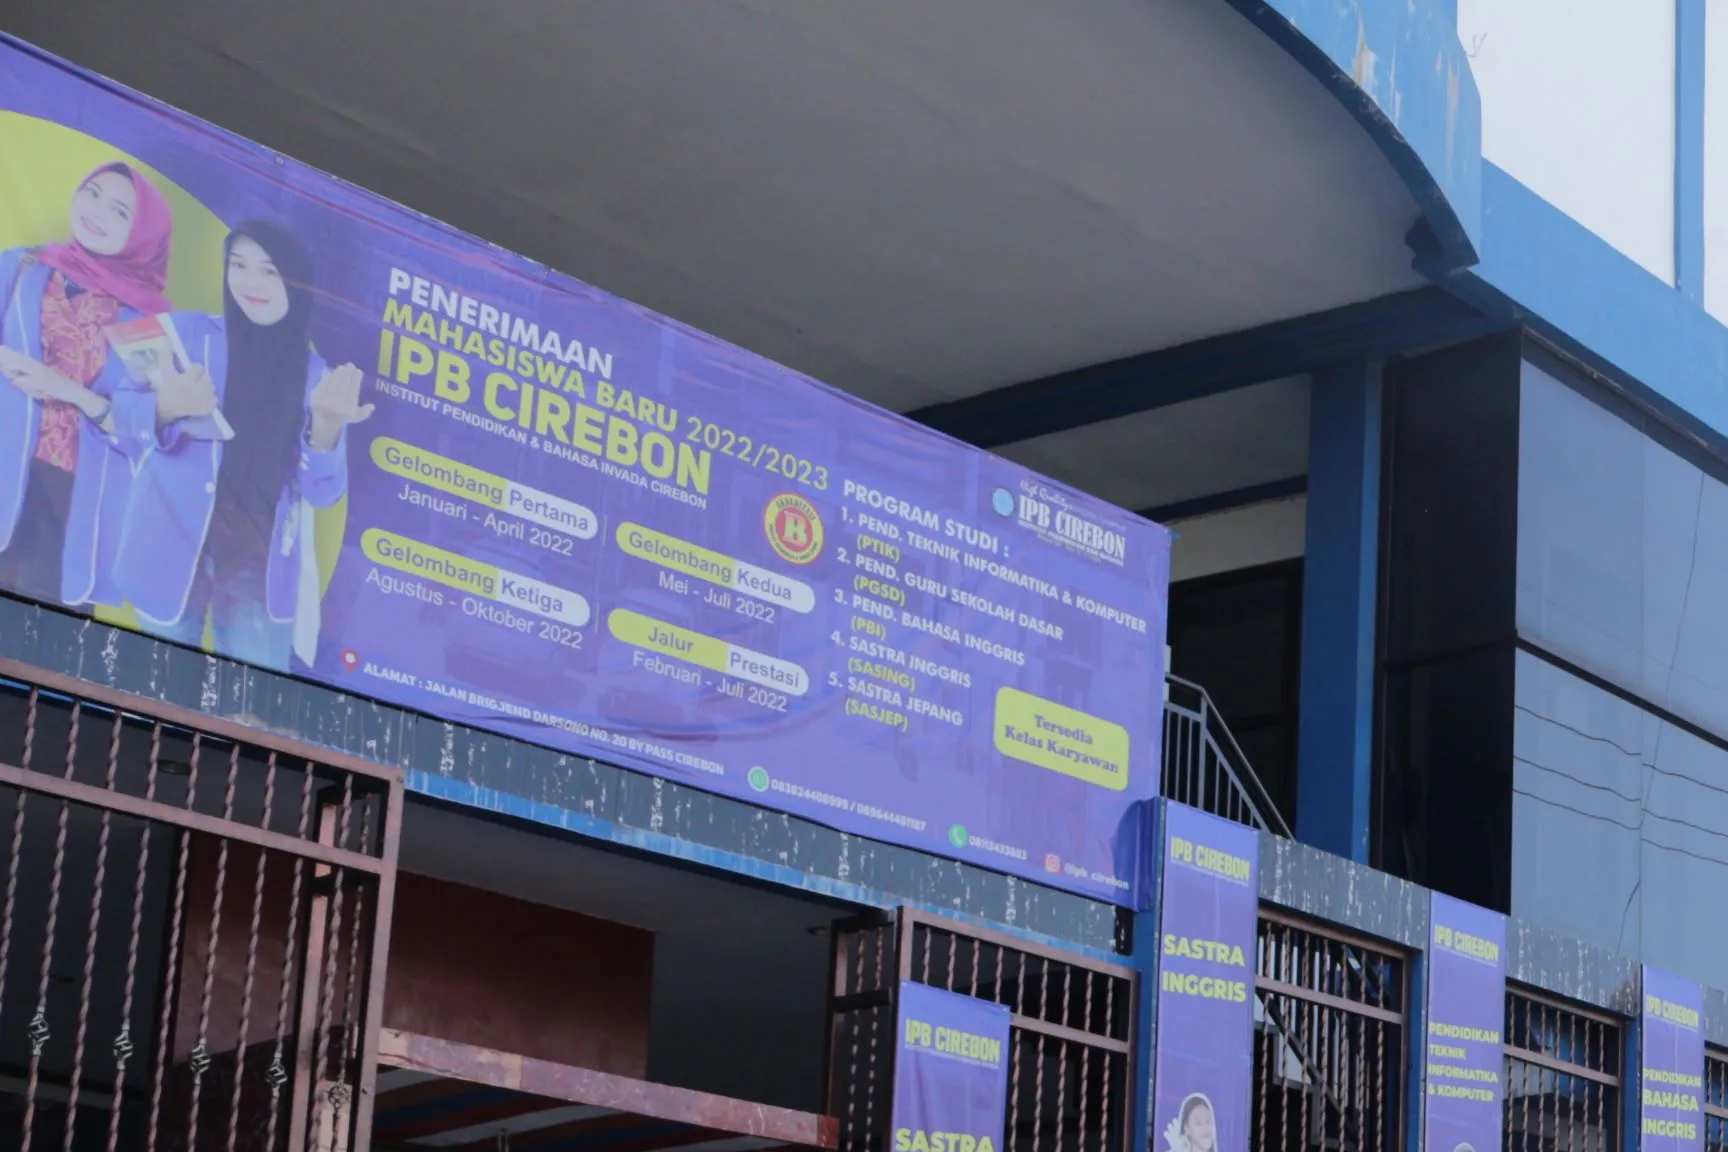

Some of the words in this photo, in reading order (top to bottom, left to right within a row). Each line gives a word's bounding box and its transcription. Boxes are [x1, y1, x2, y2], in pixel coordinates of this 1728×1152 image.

[390, 267, 612, 378] PENERIMAAN
[377, 329, 471, 402] IPB
[483, 374, 712, 494] CIREBON
[383, 300, 586, 398] MAHASISWA
[596, 380, 678, 432] BARU
[687, 417, 829, 490] 2022/2023
[376, 379, 439, 411] INSTITUT
[442, 403, 527, 444] PENDIDIKAN
[530, 437, 539, 449] &
[543, 442, 598, 470] BAHASA
[601, 461, 647, 488] INVADA
[650, 480, 707, 509] CIREBON
[384, 447, 504, 505] Gelombang
[509, 489, 589, 532] Pertama
[398, 484, 467, 521] Januari
[484, 513, 526, 543] April
[530, 529, 574, 556] 2022
[843, 480, 939, 534] PROGRAM
[945, 519, 997, 555] STUDI
[1019, 495, 1050, 527] IPB
[1055, 511, 1126, 559] CIREBON
[629, 532, 732, 582] Gelombang
[737, 567, 792, 601] Kedua
[842, 507, 853, 524] 1.
[858, 513, 902, 541] PEND.
[908, 532, 959, 564] TEKNIK
[964, 553, 1058, 601] INFORMATIKA
[1063, 591, 1072, 604] &
[1076, 594, 1146, 633] KOMPUTER
[857, 533, 900, 562] (PTIK)
[376, 538, 495, 594] Gelombang
[501, 578, 563, 617] Ketiga
[658, 571, 690, 595] Mei
[704, 589, 731, 612] Juli
[735, 599, 776, 623] 2022
[838, 548, 851, 566] 2.
[856, 553, 899, 583] PEND.
[904, 572, 947, 599] GURU
[951, 589, 1014, 622] SEKOLAH
[1019, 611, 1064, 641] DASAR
[854, 574, 905, 606] (PGSD)
[367, 568, 443, 610] Agustus
[462, 598, 534, 634] Oktober
[539, 622, 583, 649] 2022
[835, 589, 847, 605] 3.
[853, 594, 897, 622] PEND.
[902, 613, 961, 645] BAHASA
[965, 633, 1025, 667] INGGRIS
[851, 615, 886, 641] (PBI)
[633, 651, 700, 686] Februari
[717, 678, 744, 700] Juli
[748, 689, 788, 713] 2022
[648, 626, 694, 655] Jalur
[730, 651, 800, 688] Prestasi
[831, 631, 844, 647] 4.
[850, 636, 905, 667] SASTRA
[909, 654, 971, 688] INGGRIS
[848, 656, 915, 693] (SASING)
[363, 663, 416, 688] ALAMAT
[426, 680, 466, 701] JALAN
[533, 708, 588, 737] DARSONO
[612, 732, 628, 749] 20
[629, 737, 644, 754] BY
[646, 741, 674, 762] PASS
[676, 751, 724, 775] CIREBON
[828, 671, 843, 688] 5.
[847, 676, 901, 706] SASTRA
[906, 694, 963, 725] JEPANG
[845, 697, 908, 732] (SASJEP)
[1005, 724, 1044, 750] Kelas
[1047, 738, 1119, 775] Karyawan
[1034, 713, 1093, 746] Tersedia
[1171, 836, 1192, 863] IPB
[1196, 845, 1250, 881] CIREBON
[1164, 934, 1245, 967] SASTRA
[1162, 971, 1246, 1002] INGGRIS
[905, 1018, 932, 1047] IPB
[936, 1026, 1001, 1064] CIREBON
[1428, 1022, 1498, 1044] PENDIDIKAN
[1428, 1063, 1498, 1083] INFORMATIKA
[1437, 1085, 1493, 1102] KOMPUTER
[1643, 1089, 1699, 1112] BAHASA
[1643, 1118, 1697, 1139] INGGRIS
